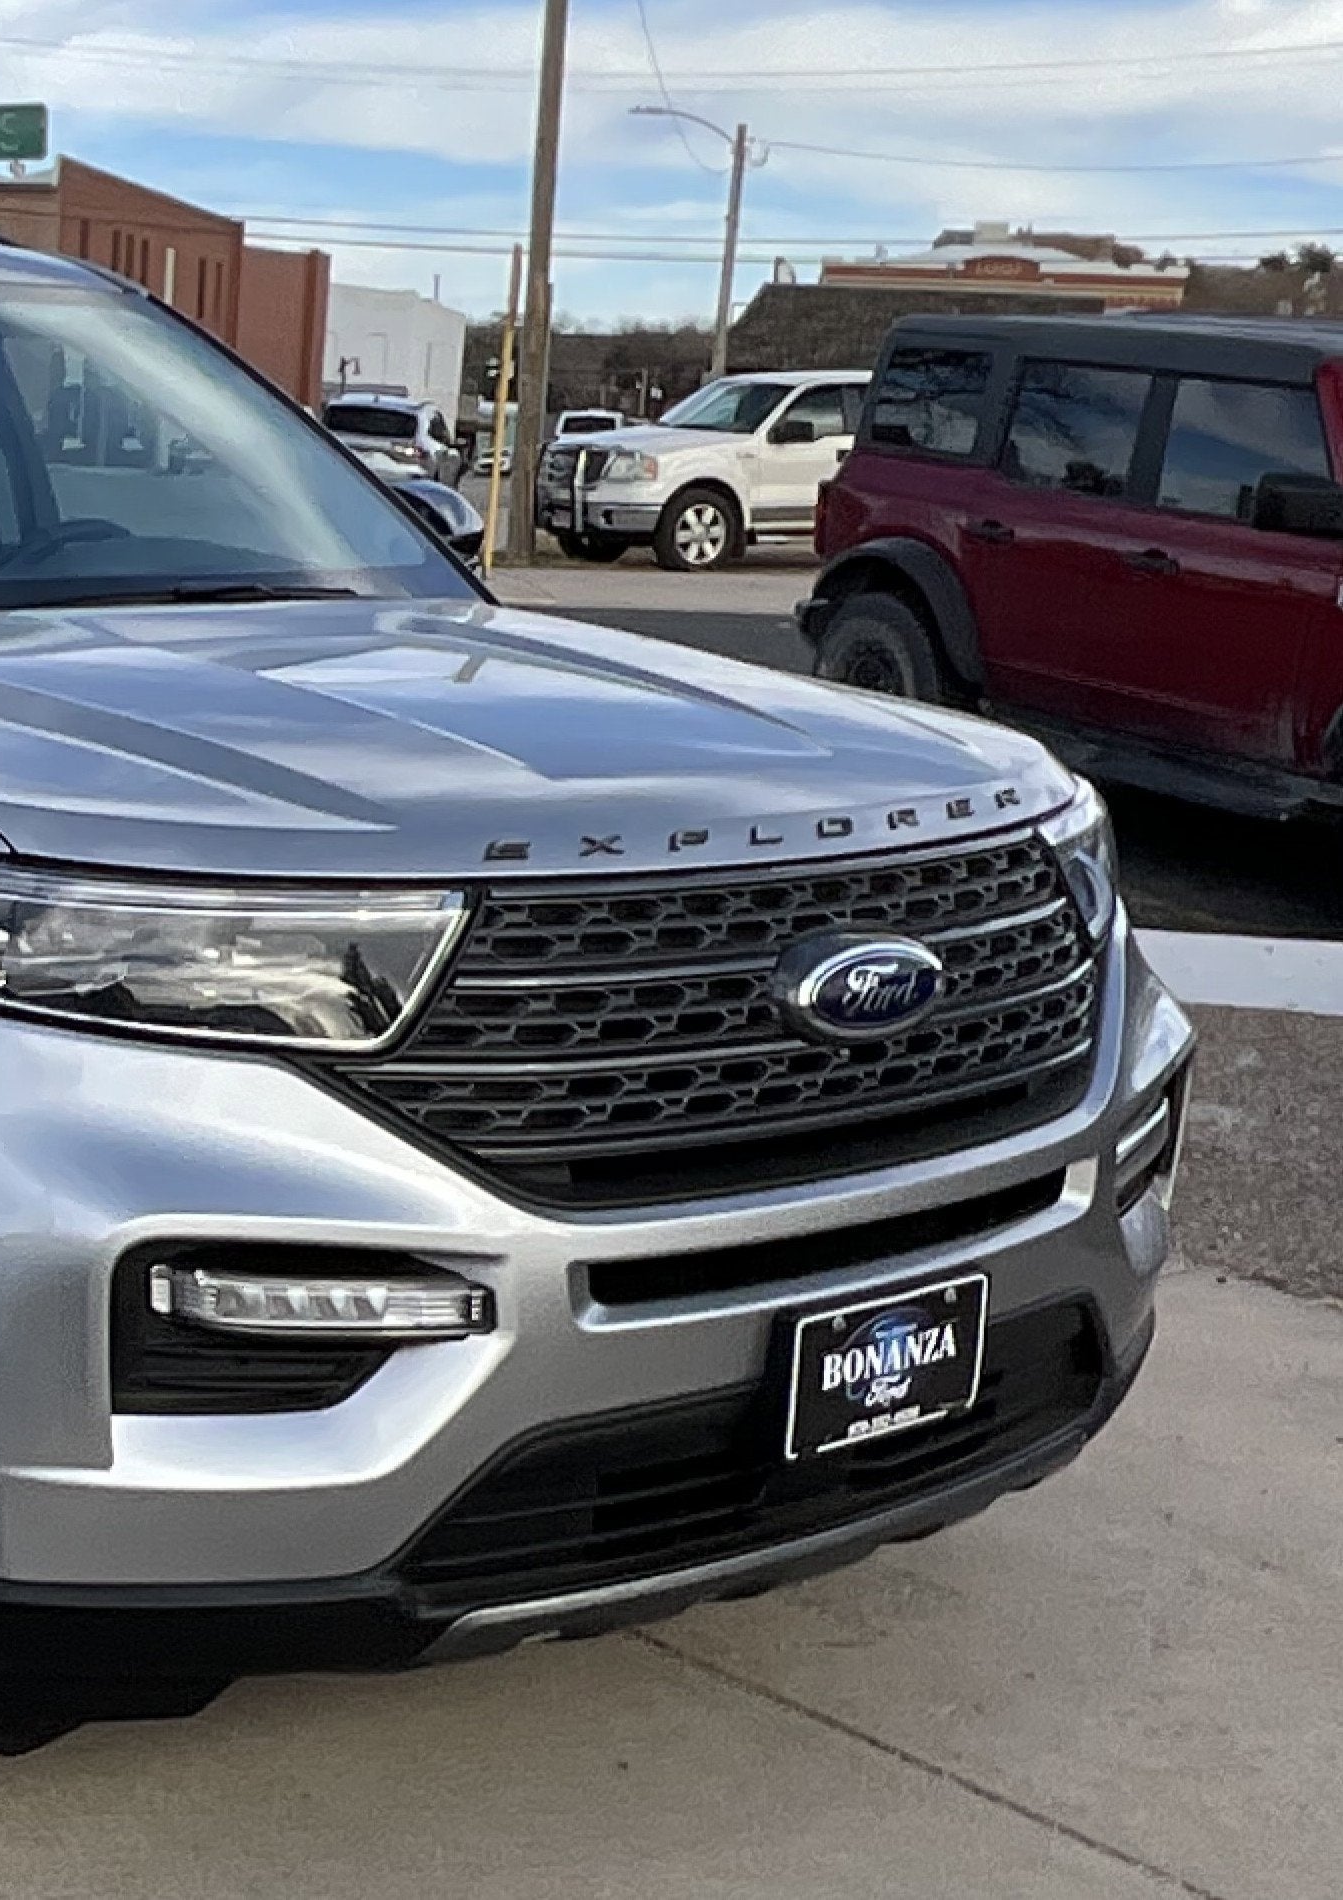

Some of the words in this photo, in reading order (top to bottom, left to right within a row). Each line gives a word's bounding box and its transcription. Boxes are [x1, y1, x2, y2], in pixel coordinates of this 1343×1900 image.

[483, 787, 1021, 861] EXPLORER
[841, 962, 920, 1017] Ford
[821, 1323, 957, 1391] BONANZA
